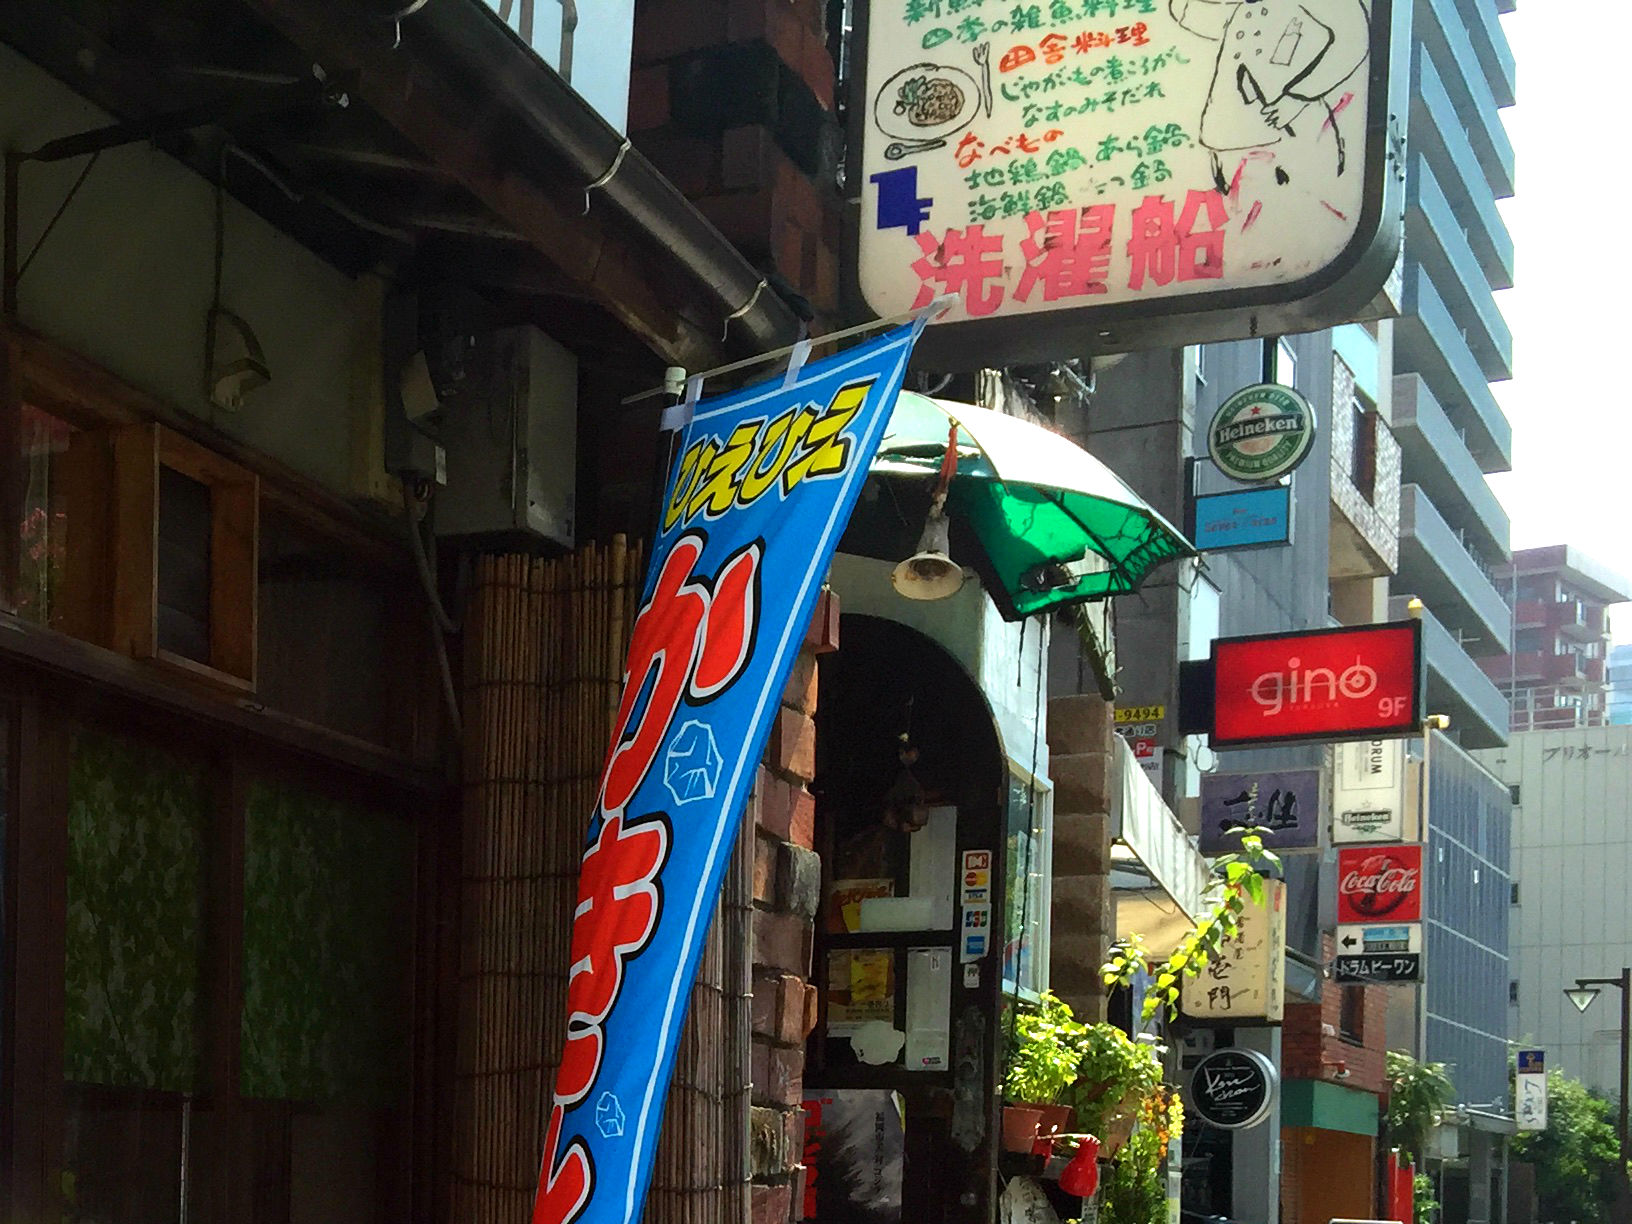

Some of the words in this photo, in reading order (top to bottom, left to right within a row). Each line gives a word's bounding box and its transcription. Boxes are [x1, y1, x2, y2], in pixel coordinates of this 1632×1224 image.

[998, 21, 1151, 73] 田舎料理
[1022, 81, 1166, 128] なすのみそだれ
[954, 129, 1065, 168] なべもの
[910, 188, 1229, 320] 洗濯船
[1219, 416, 1300, 444] Heineken
[664, 379, 878, 533] ひえひえ
[1250, 655, 1378, 716] gino
[1377, 696, 1407, 719] 9F
